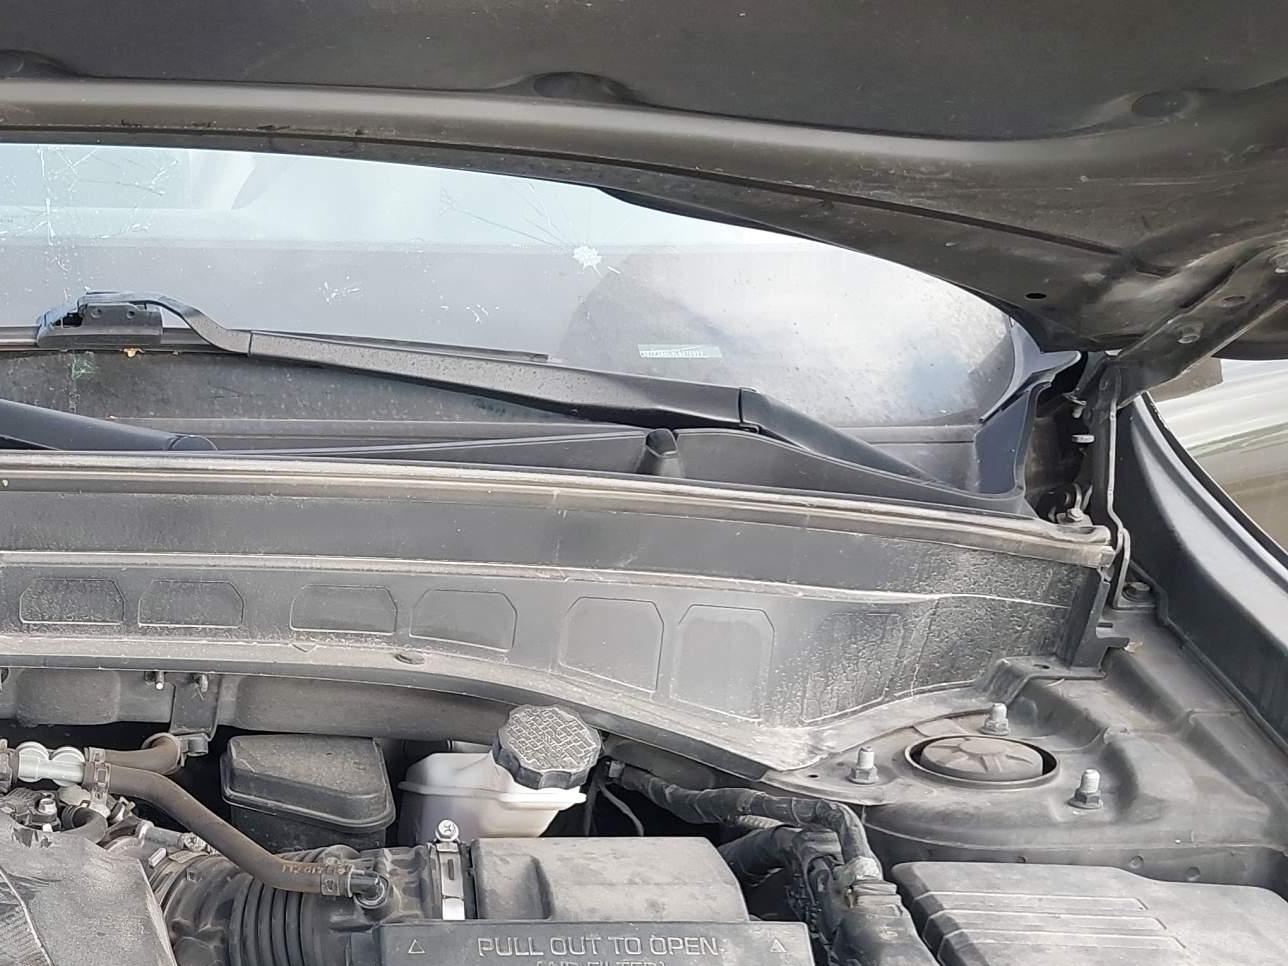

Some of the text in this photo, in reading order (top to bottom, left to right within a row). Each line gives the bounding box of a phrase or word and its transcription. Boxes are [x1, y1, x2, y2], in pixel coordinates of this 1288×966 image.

[478, 937, 719, 957] PULL OUT TO OPEN
